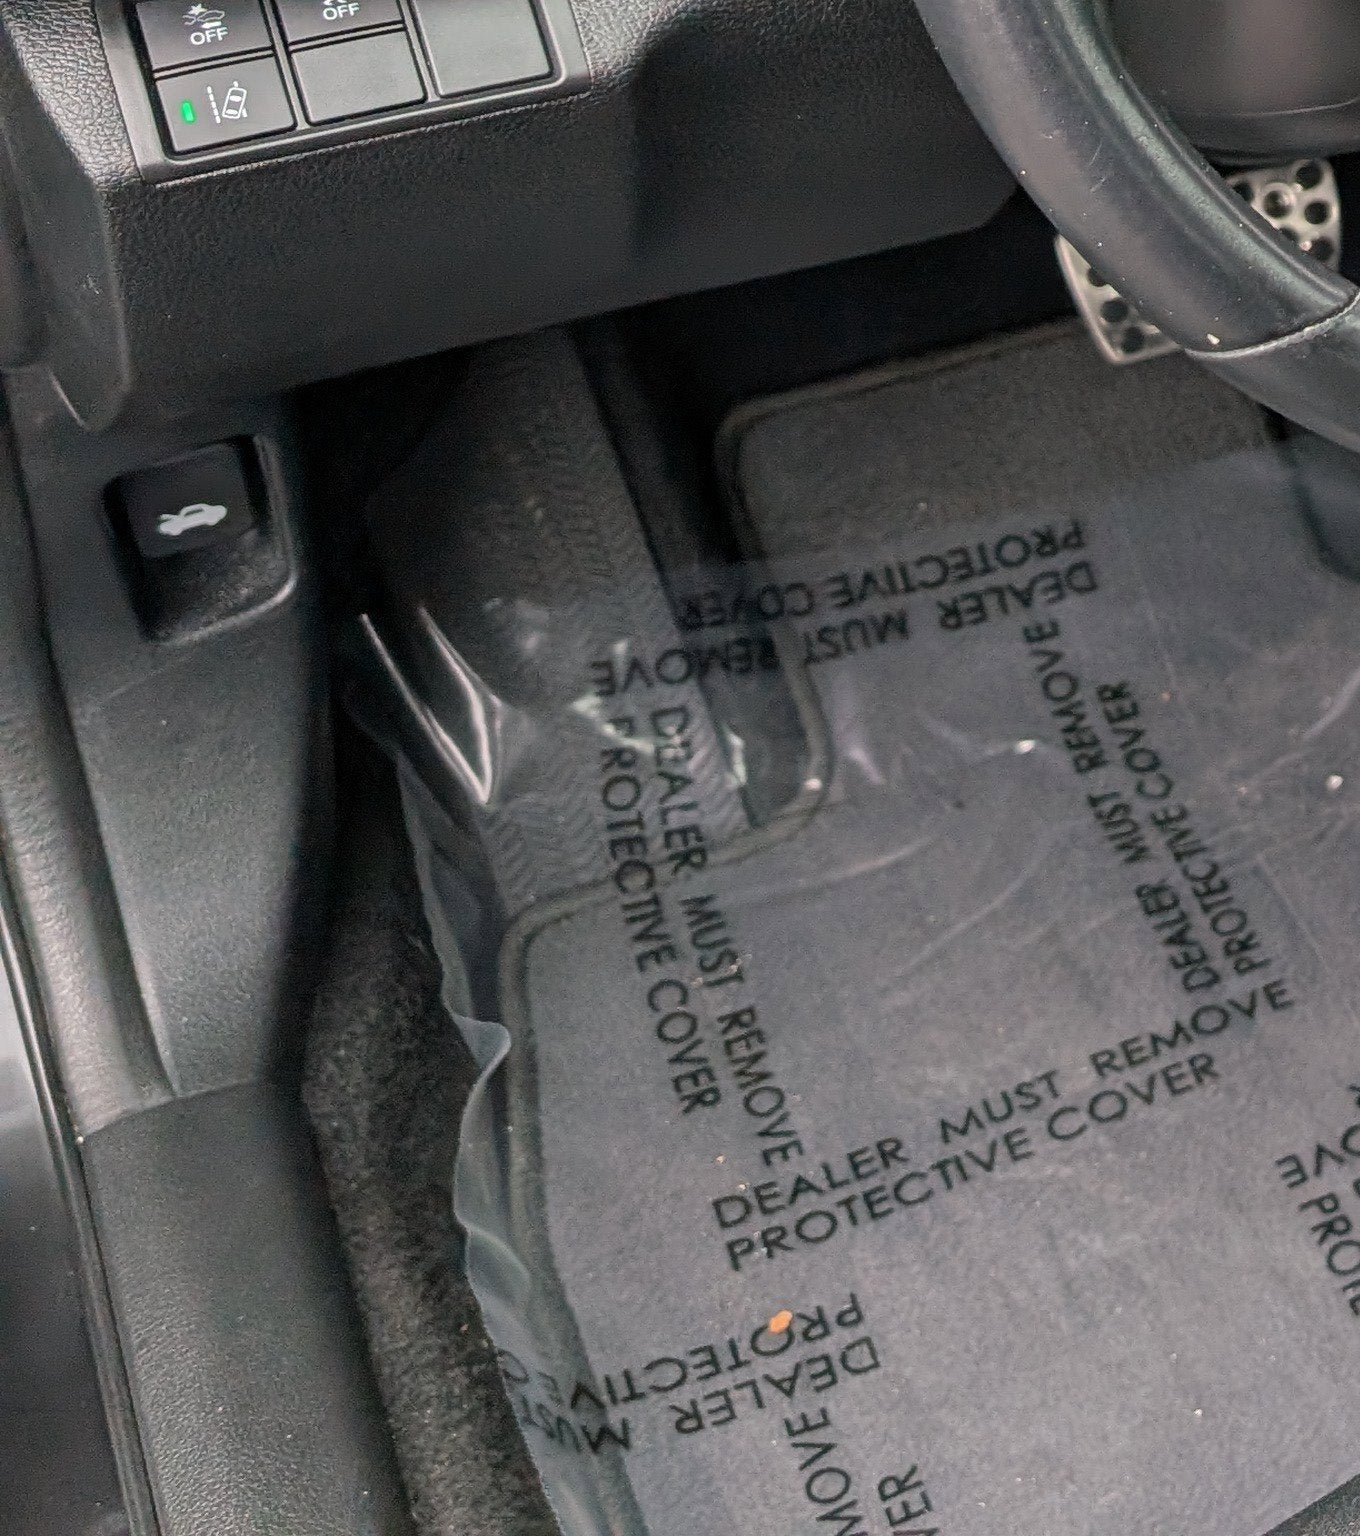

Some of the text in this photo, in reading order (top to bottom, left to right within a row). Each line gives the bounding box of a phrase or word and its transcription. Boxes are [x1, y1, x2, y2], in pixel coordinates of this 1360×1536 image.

[190, 26, 229, 47] OFF
[322, 1, 360, 22] OFF
[677, 517, 1088, 632] PROTECTIVE COVER
[797, 608, 911, 665] MUST
[936, 558, 1099, 632] DEALER
[1022, 616, 1221, 994] REMOVE MUST DEALER
[1097, 679, 1272, 977] COVER PROTECTIVE
[599, 716, 723, 1116] PROTECTIVE COVER
[679, 893, 746, 989] MUST
[717, 1004, 805, 1167] REMOVE
[711, 978, 1297, 1231] DEALER MUST REMOVE
[725, 1051, 1222, 1272] PROTECTIVE COVER
[668, 1335, 882, 1435] DEALER
